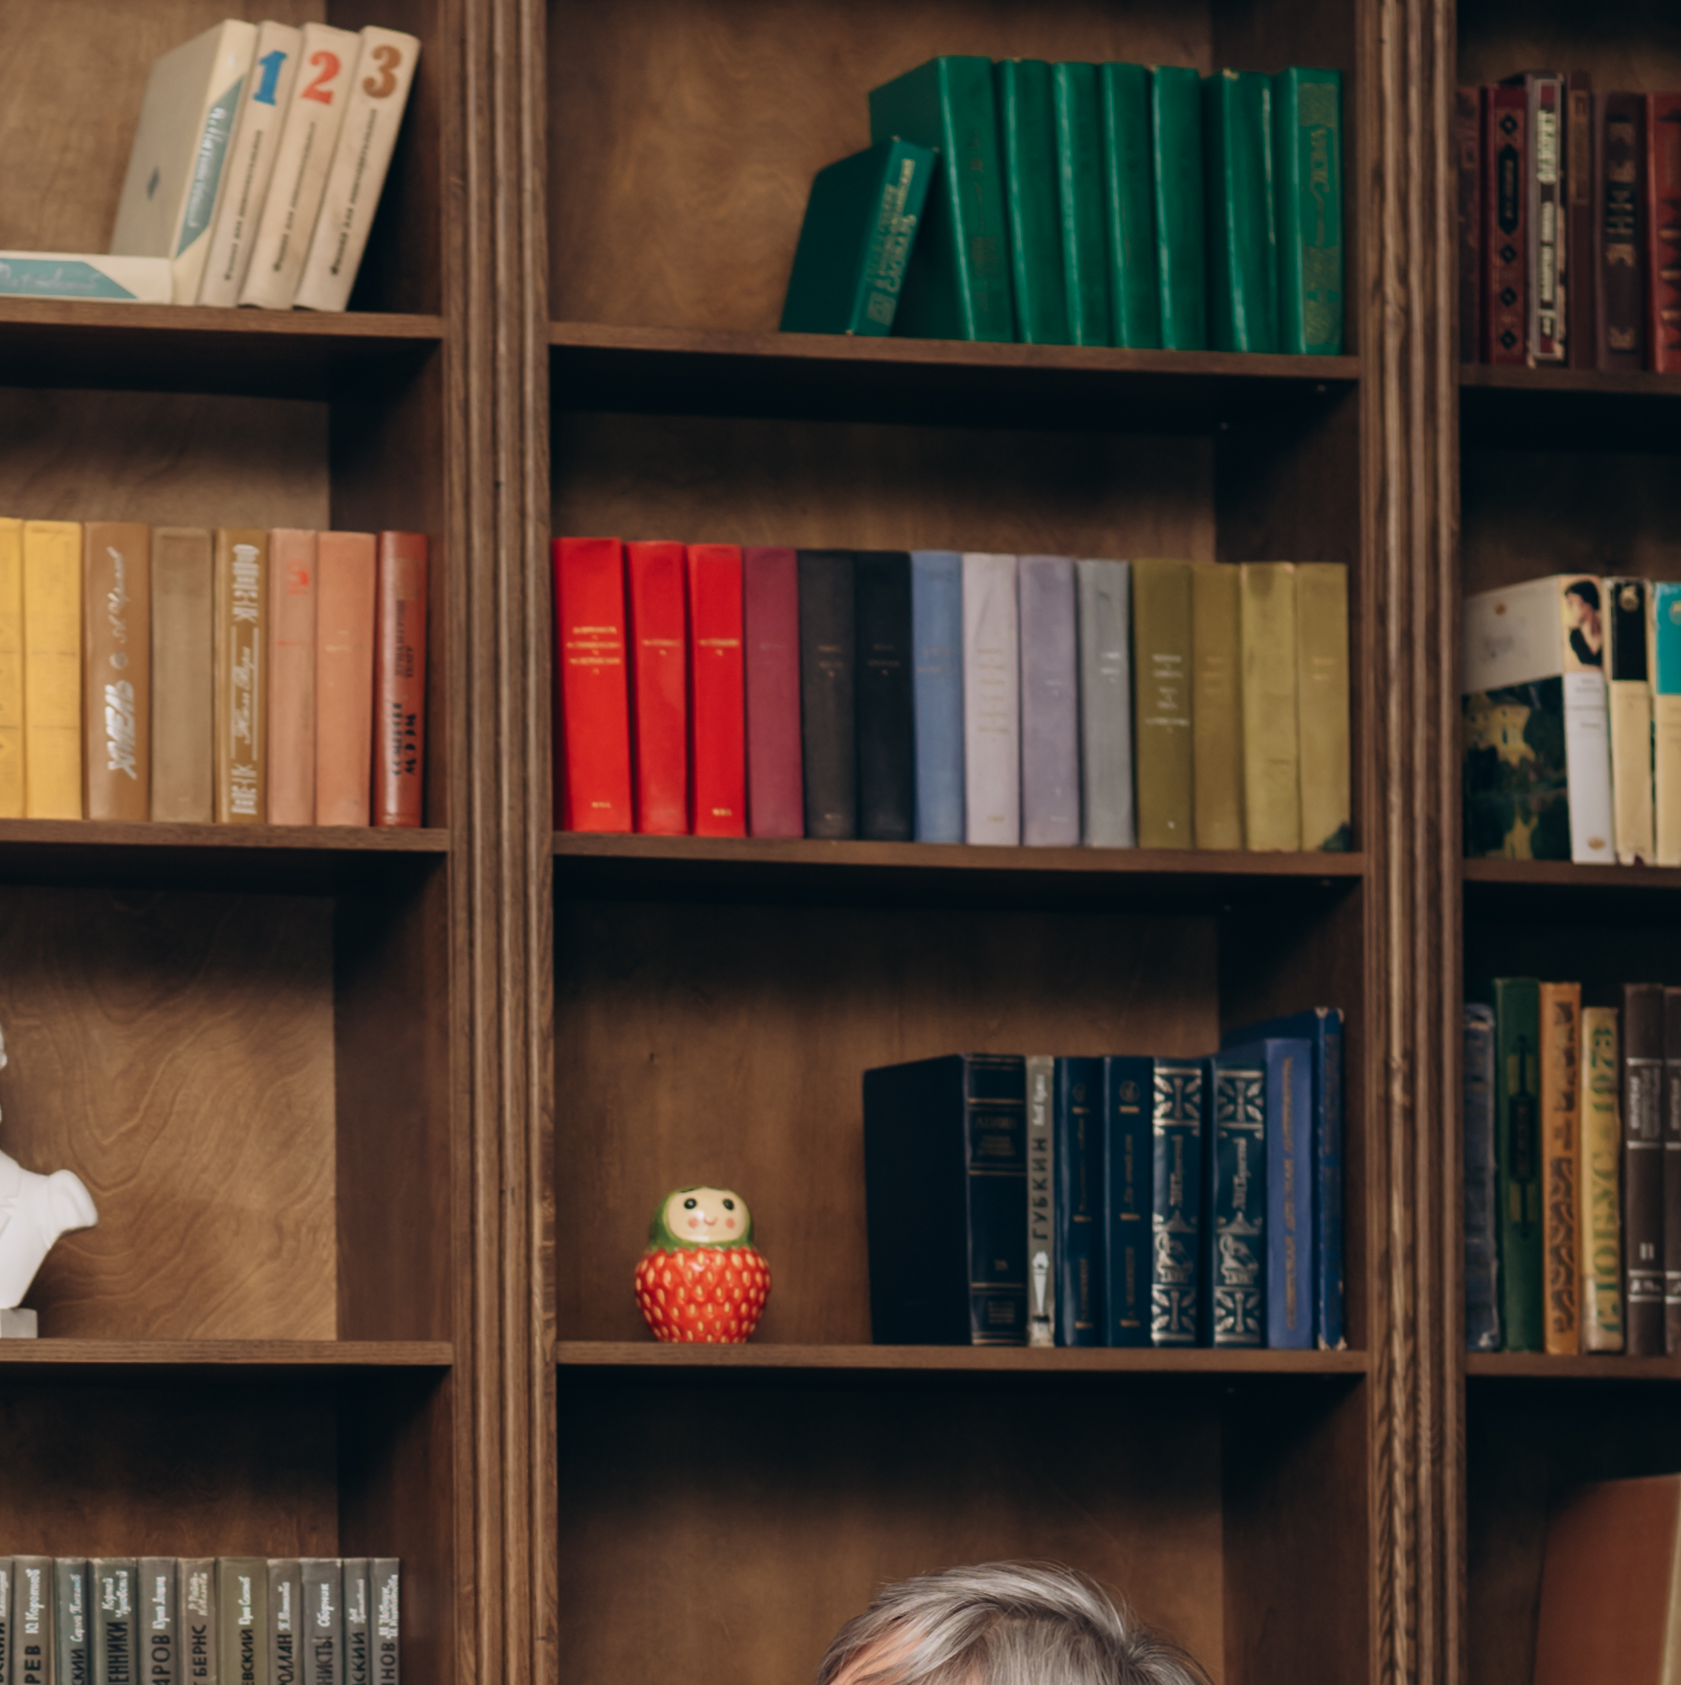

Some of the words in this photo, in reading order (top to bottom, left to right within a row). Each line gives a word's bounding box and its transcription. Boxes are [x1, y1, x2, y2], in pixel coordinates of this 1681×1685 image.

[253, 49, 287, 106] 1
[300, 49, 342, 106] 2
[362, 45, 402, 99] 3
[1031, 1137, 1048, 1240] ГУБКИН
[191, 1624, 208, 1679] БЕРНС
